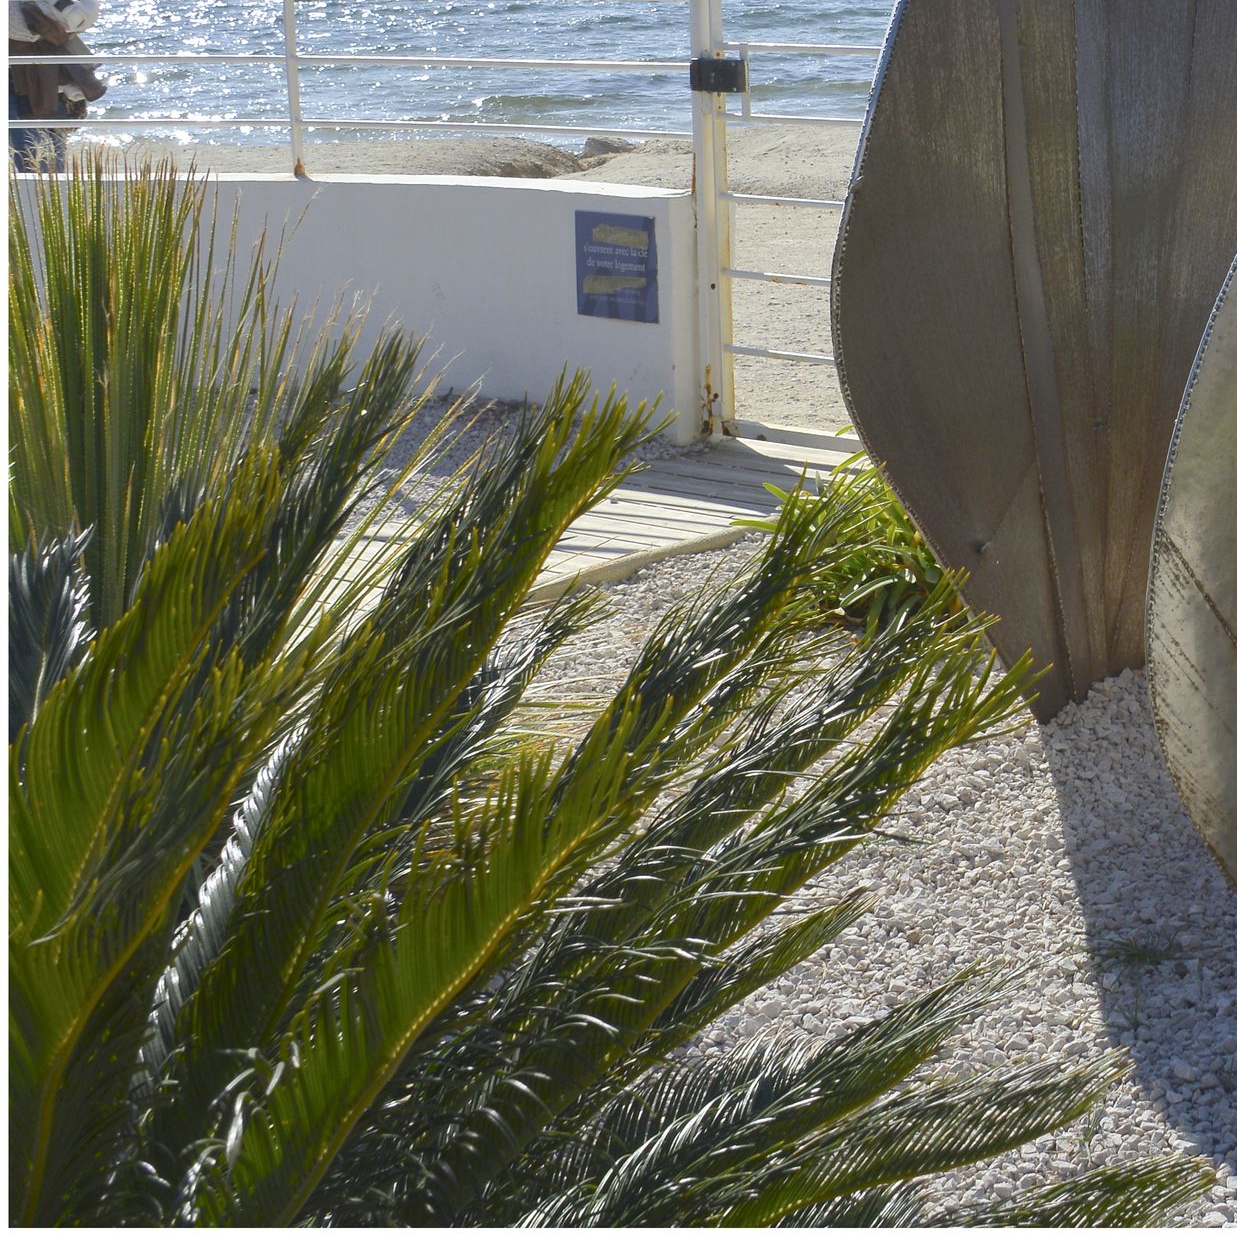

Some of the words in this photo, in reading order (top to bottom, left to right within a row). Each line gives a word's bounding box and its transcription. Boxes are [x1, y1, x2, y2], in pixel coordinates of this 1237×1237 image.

[615, 248, 629, 256] avec
[630, 246, 637, 257] la
[587, 256, 595, 267] de
[597, 259, 614, 268] votre
[615, 258, 645, 272] logement
